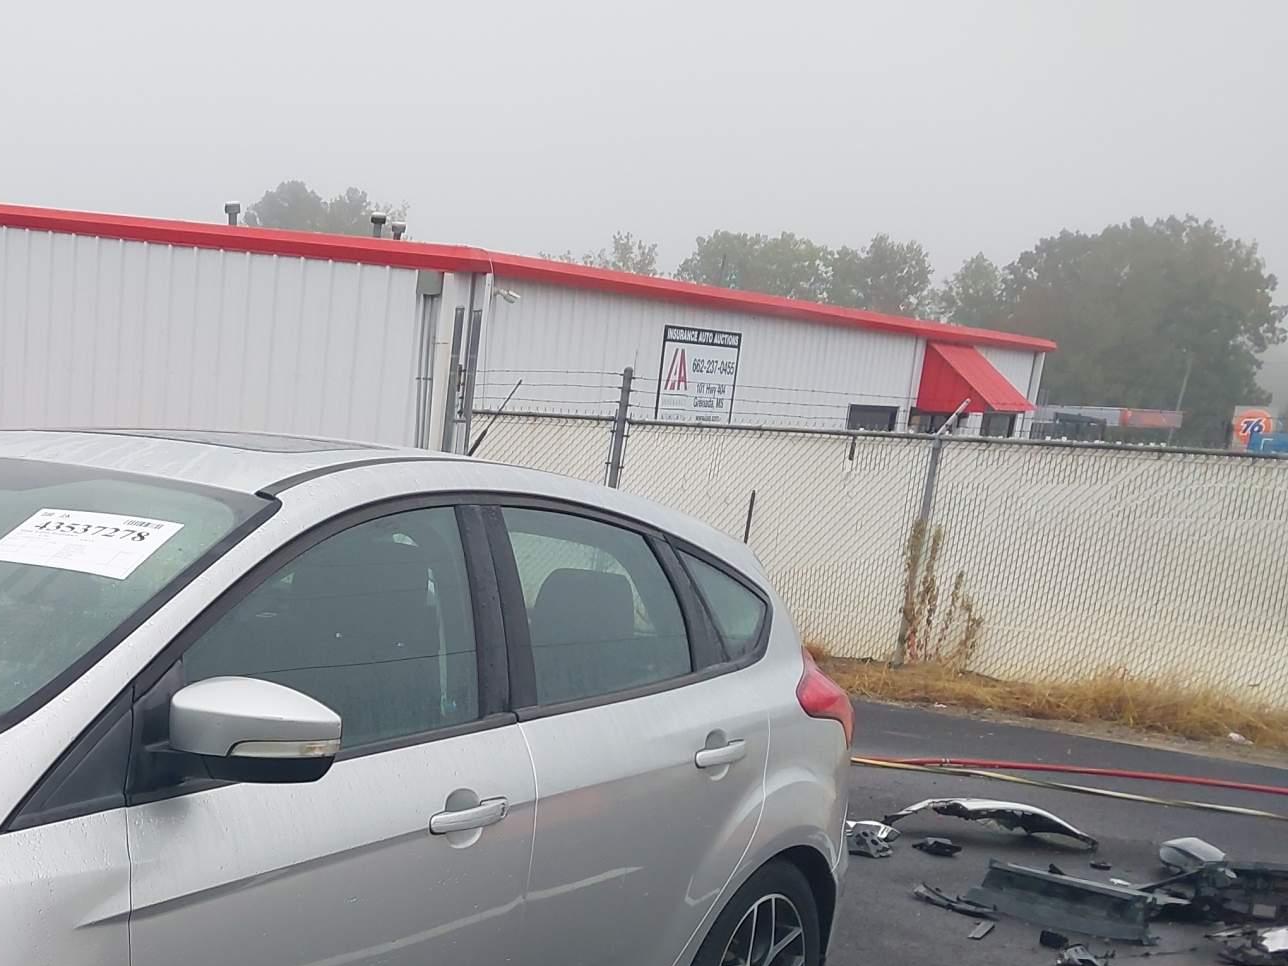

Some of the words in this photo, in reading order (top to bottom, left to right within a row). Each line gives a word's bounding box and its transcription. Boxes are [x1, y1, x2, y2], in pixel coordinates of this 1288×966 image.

[667, 328, 698, 342] INSURANCE
[698, 331, 713, 344] AUTO
[713, 332, 739, 346] AUCTIONS
[692, 358, 734, 375] 662-237-0455
[696, 383, 705, 394] 101
[706, 384, 717, 397] Hwy
[1240, 417, 1265, 434] 76
[34, 520, 151, 542] 43537278
